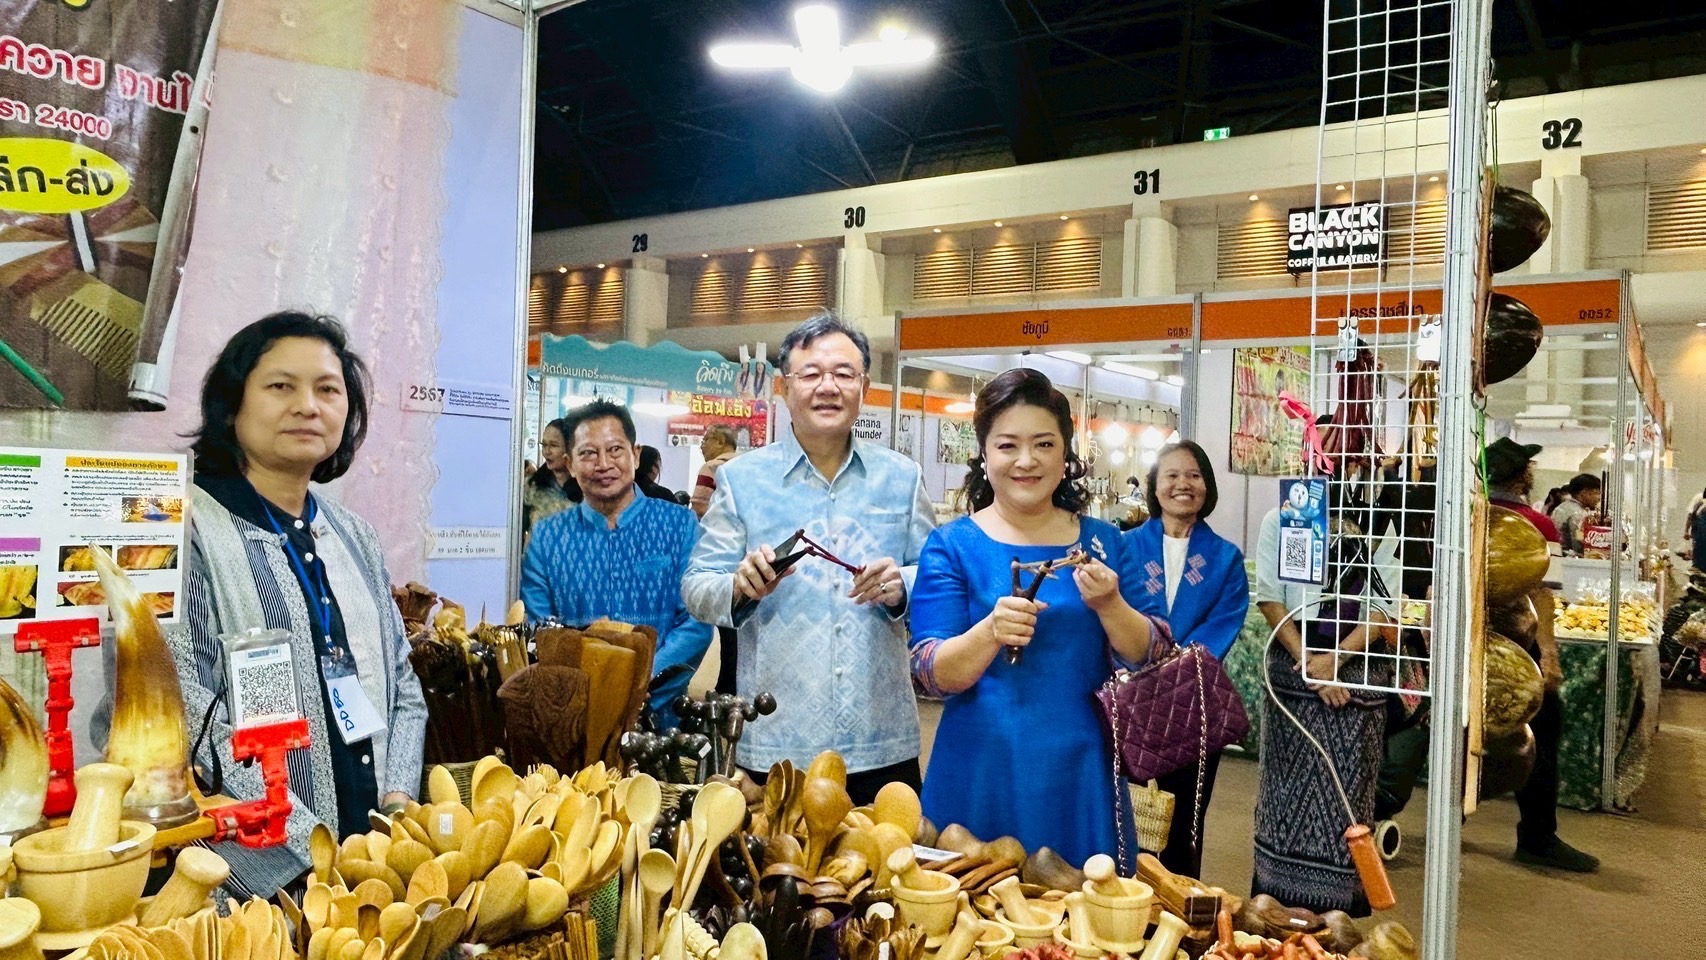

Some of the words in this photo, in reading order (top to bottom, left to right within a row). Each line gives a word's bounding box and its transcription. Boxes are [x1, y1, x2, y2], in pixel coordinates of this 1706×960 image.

[36, 104, 112, 140] 24000
[1542, 118, 1583, 150] 32
[1133, 168, 1160, 195] 31
[844, 206, 866, 229] 30
[1288, 205, 1379, 233] BLACK
[632, 233, 648, 253] 29
[1288, 228, 1379, 251] CANYON
[1337, 253, 1378, 264] EATERY
[854, 429, 882, 439] hunder
[855, 418, 881, 428] anana
